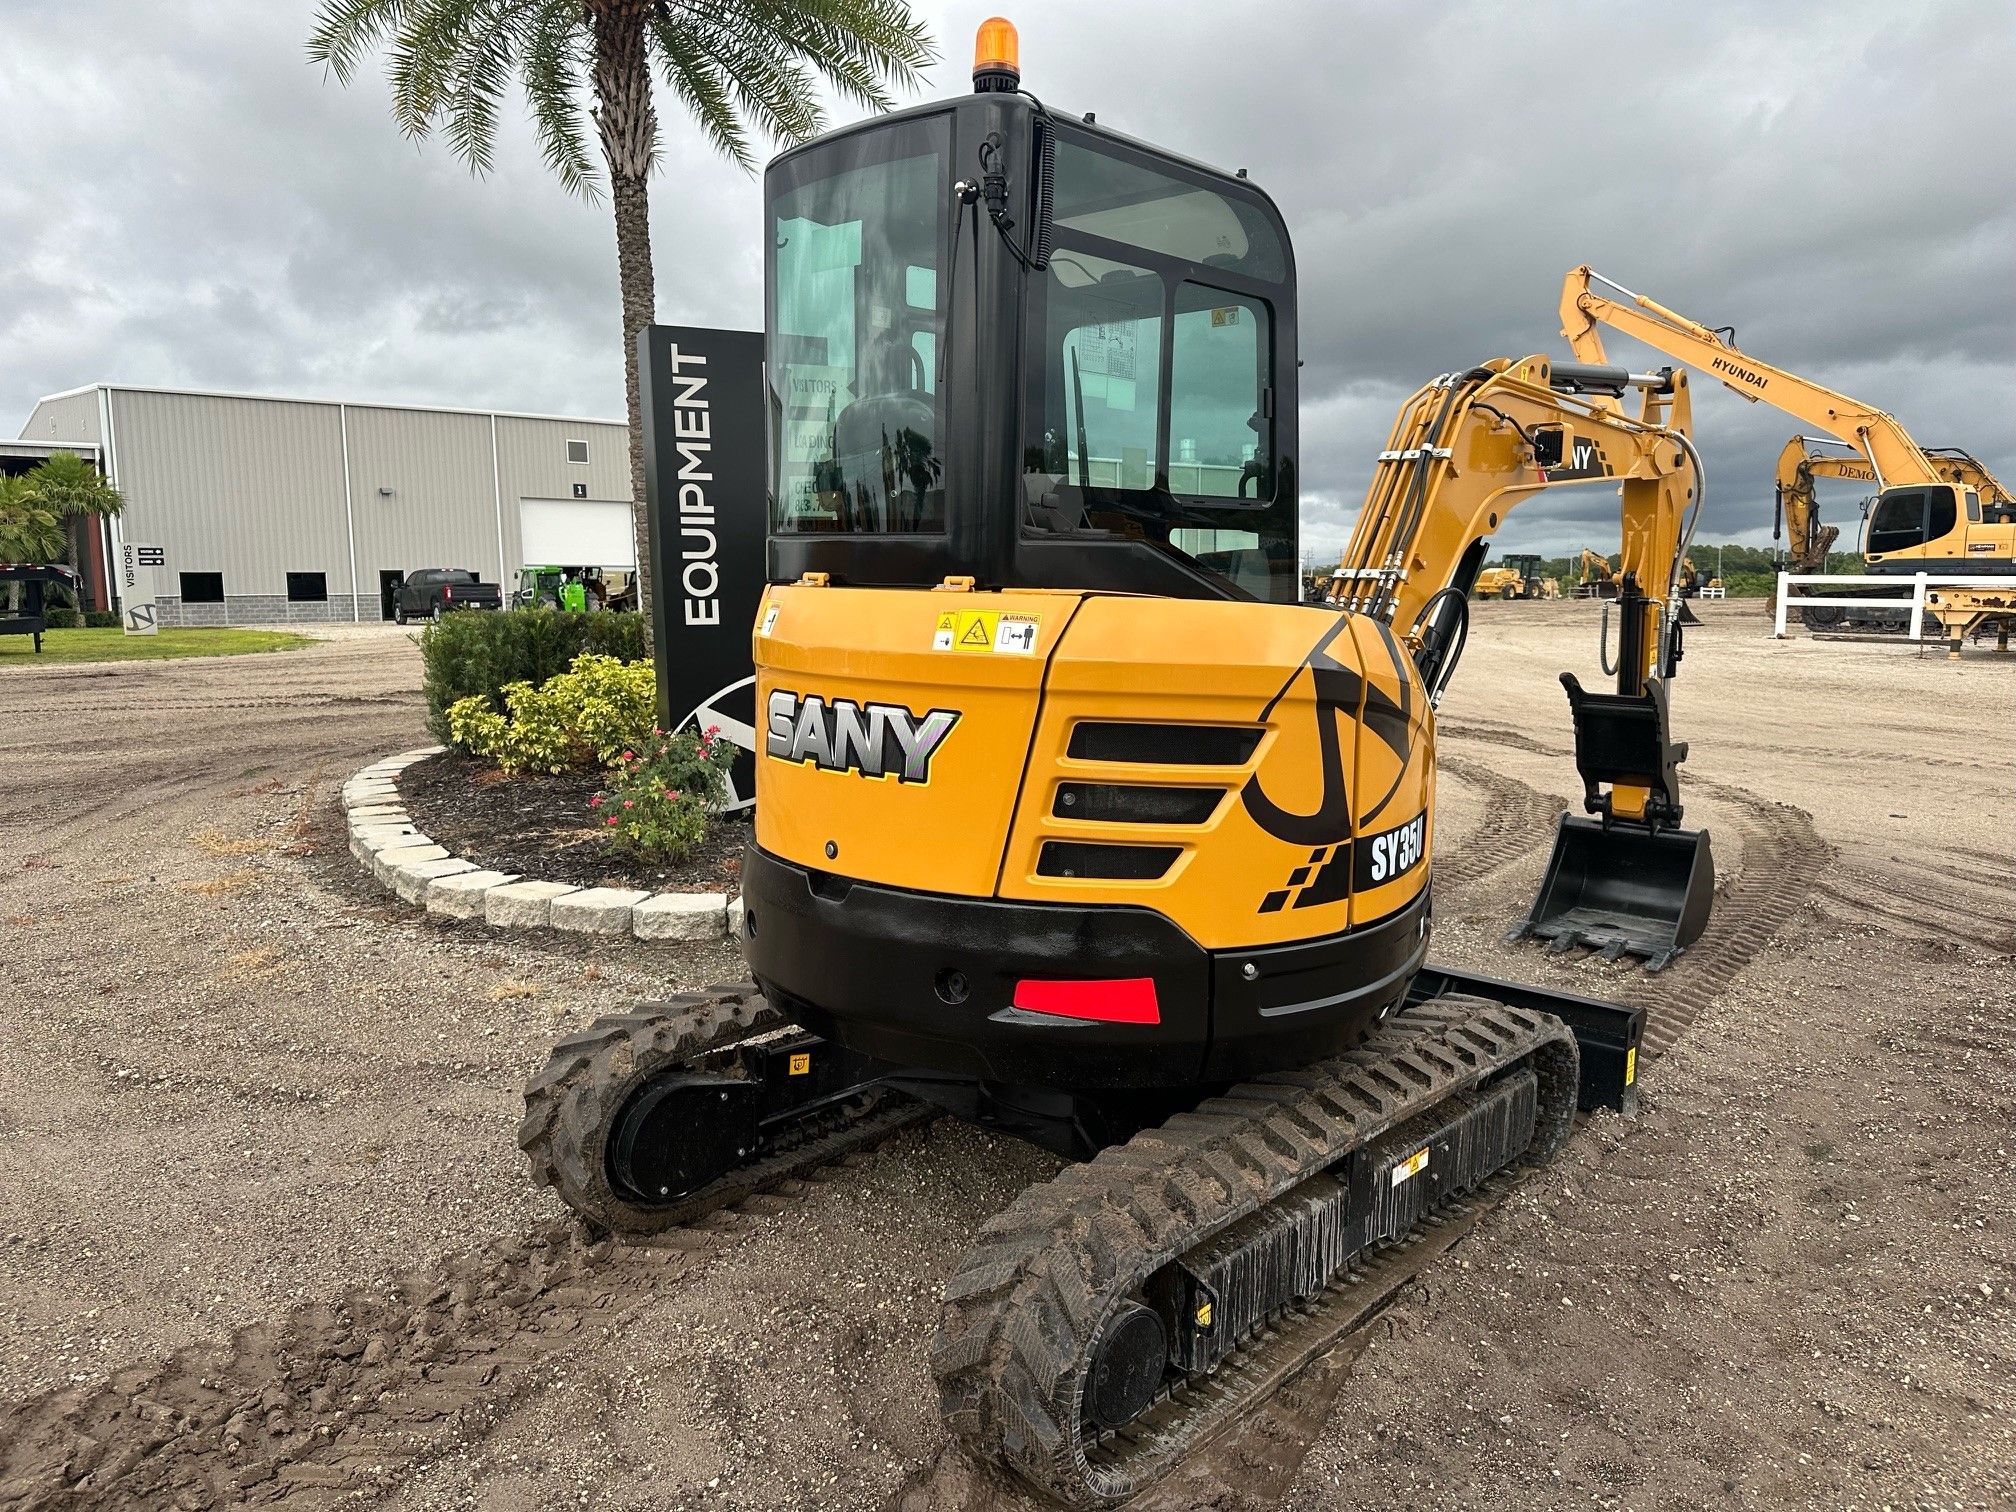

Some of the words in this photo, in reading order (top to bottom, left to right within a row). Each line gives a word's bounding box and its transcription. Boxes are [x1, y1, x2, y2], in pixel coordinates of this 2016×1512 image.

[1711, 357, 1769, 389] HYUNDAI
[577, 485, 583, 495] 1
[670, 343, 720, 626] EQUIPMENT
[123, 544, 135, 588] VISITORS
[1009, 615, 1039, 623] WARNING
[768, 689, 961, 783] SANY
[1371, 814, 1424, 881] SY35U
